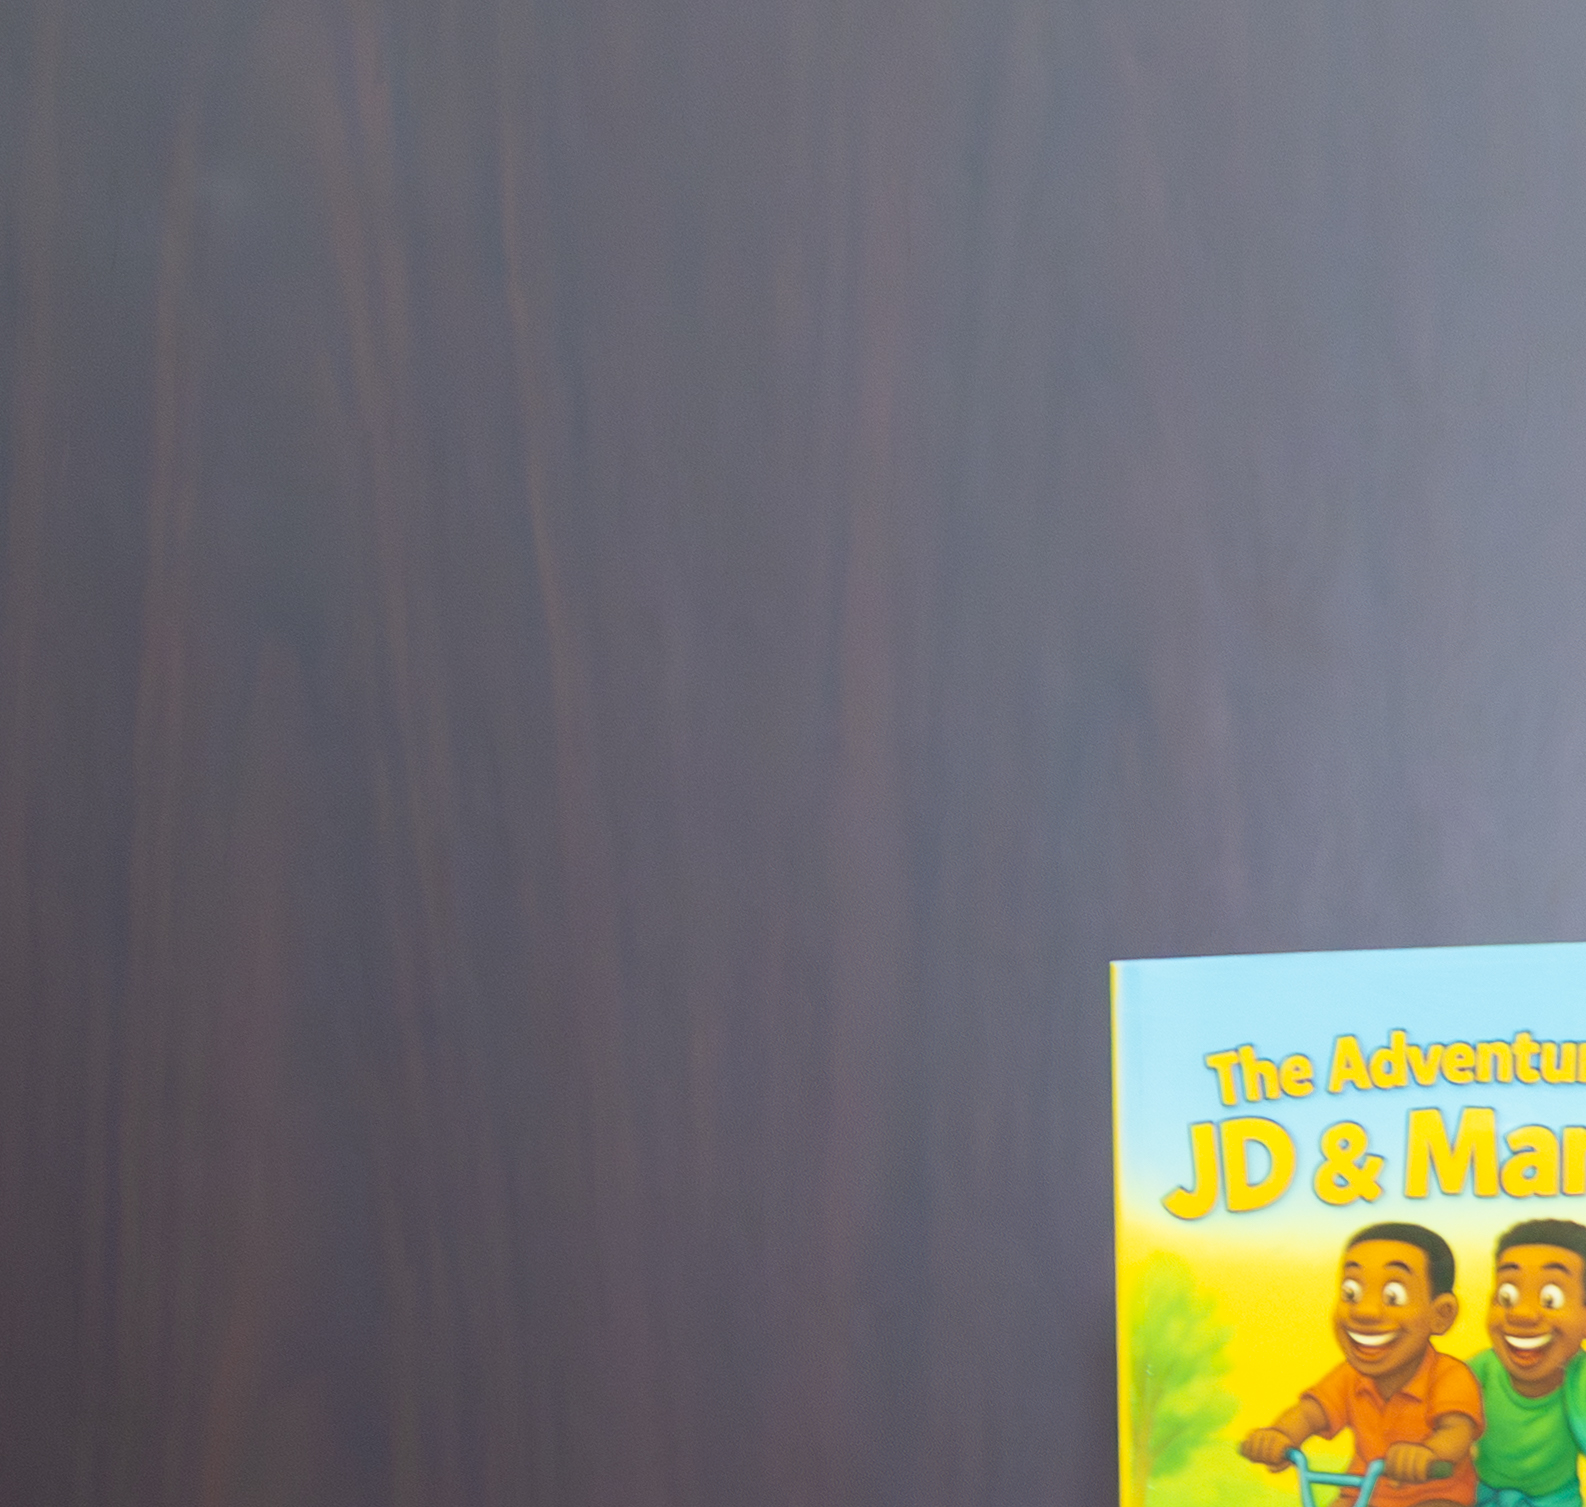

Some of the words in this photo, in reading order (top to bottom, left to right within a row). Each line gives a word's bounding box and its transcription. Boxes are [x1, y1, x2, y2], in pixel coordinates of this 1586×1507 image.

[1206, 1044, 1314, 1106] The
[1161, 1115, 1297, 1220] JD
[1313, 1121, 1385, 1205] &
